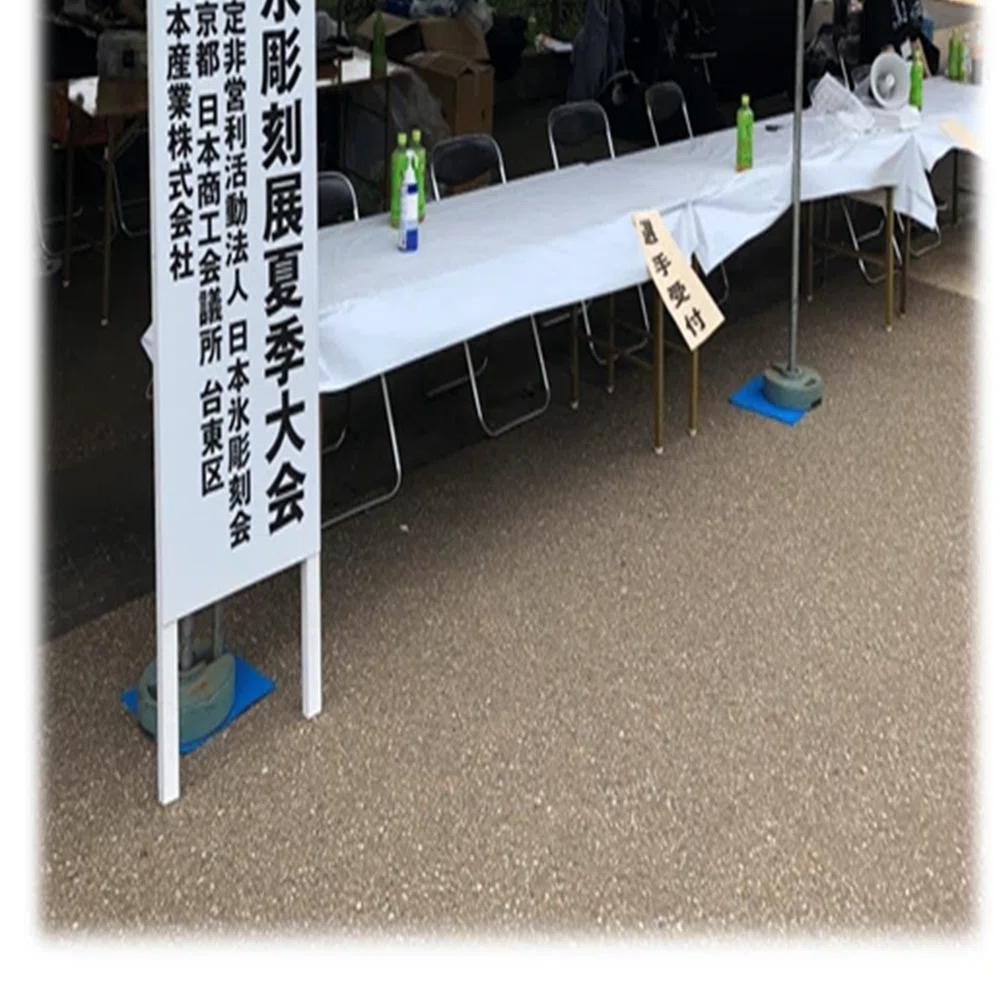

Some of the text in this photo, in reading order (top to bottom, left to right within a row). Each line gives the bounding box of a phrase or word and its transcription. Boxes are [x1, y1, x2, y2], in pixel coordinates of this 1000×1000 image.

[200, 379, 225, 497] 台東区
[227, 319, 251, 549] 日本氷彫刻会
